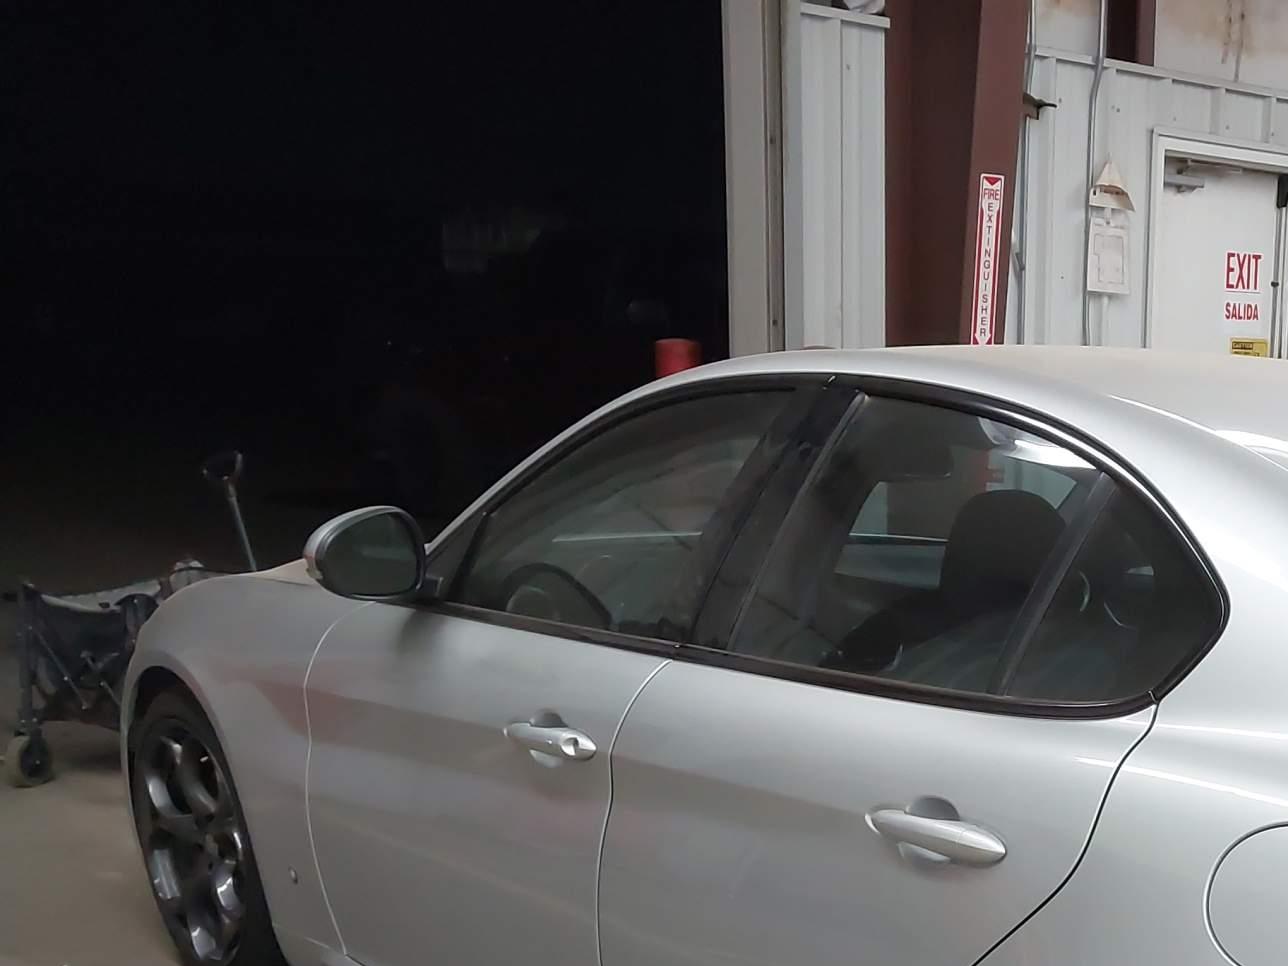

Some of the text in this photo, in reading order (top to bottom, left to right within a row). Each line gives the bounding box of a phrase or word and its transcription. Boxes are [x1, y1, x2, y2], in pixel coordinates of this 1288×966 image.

[983, 187, 1000, 201] FIRE
[979, 202, 993, 336] EXTINGUISHER
[1225, 252, 1263, 290] EXIT
[1224, 302, 1259, 320] SALIDA
